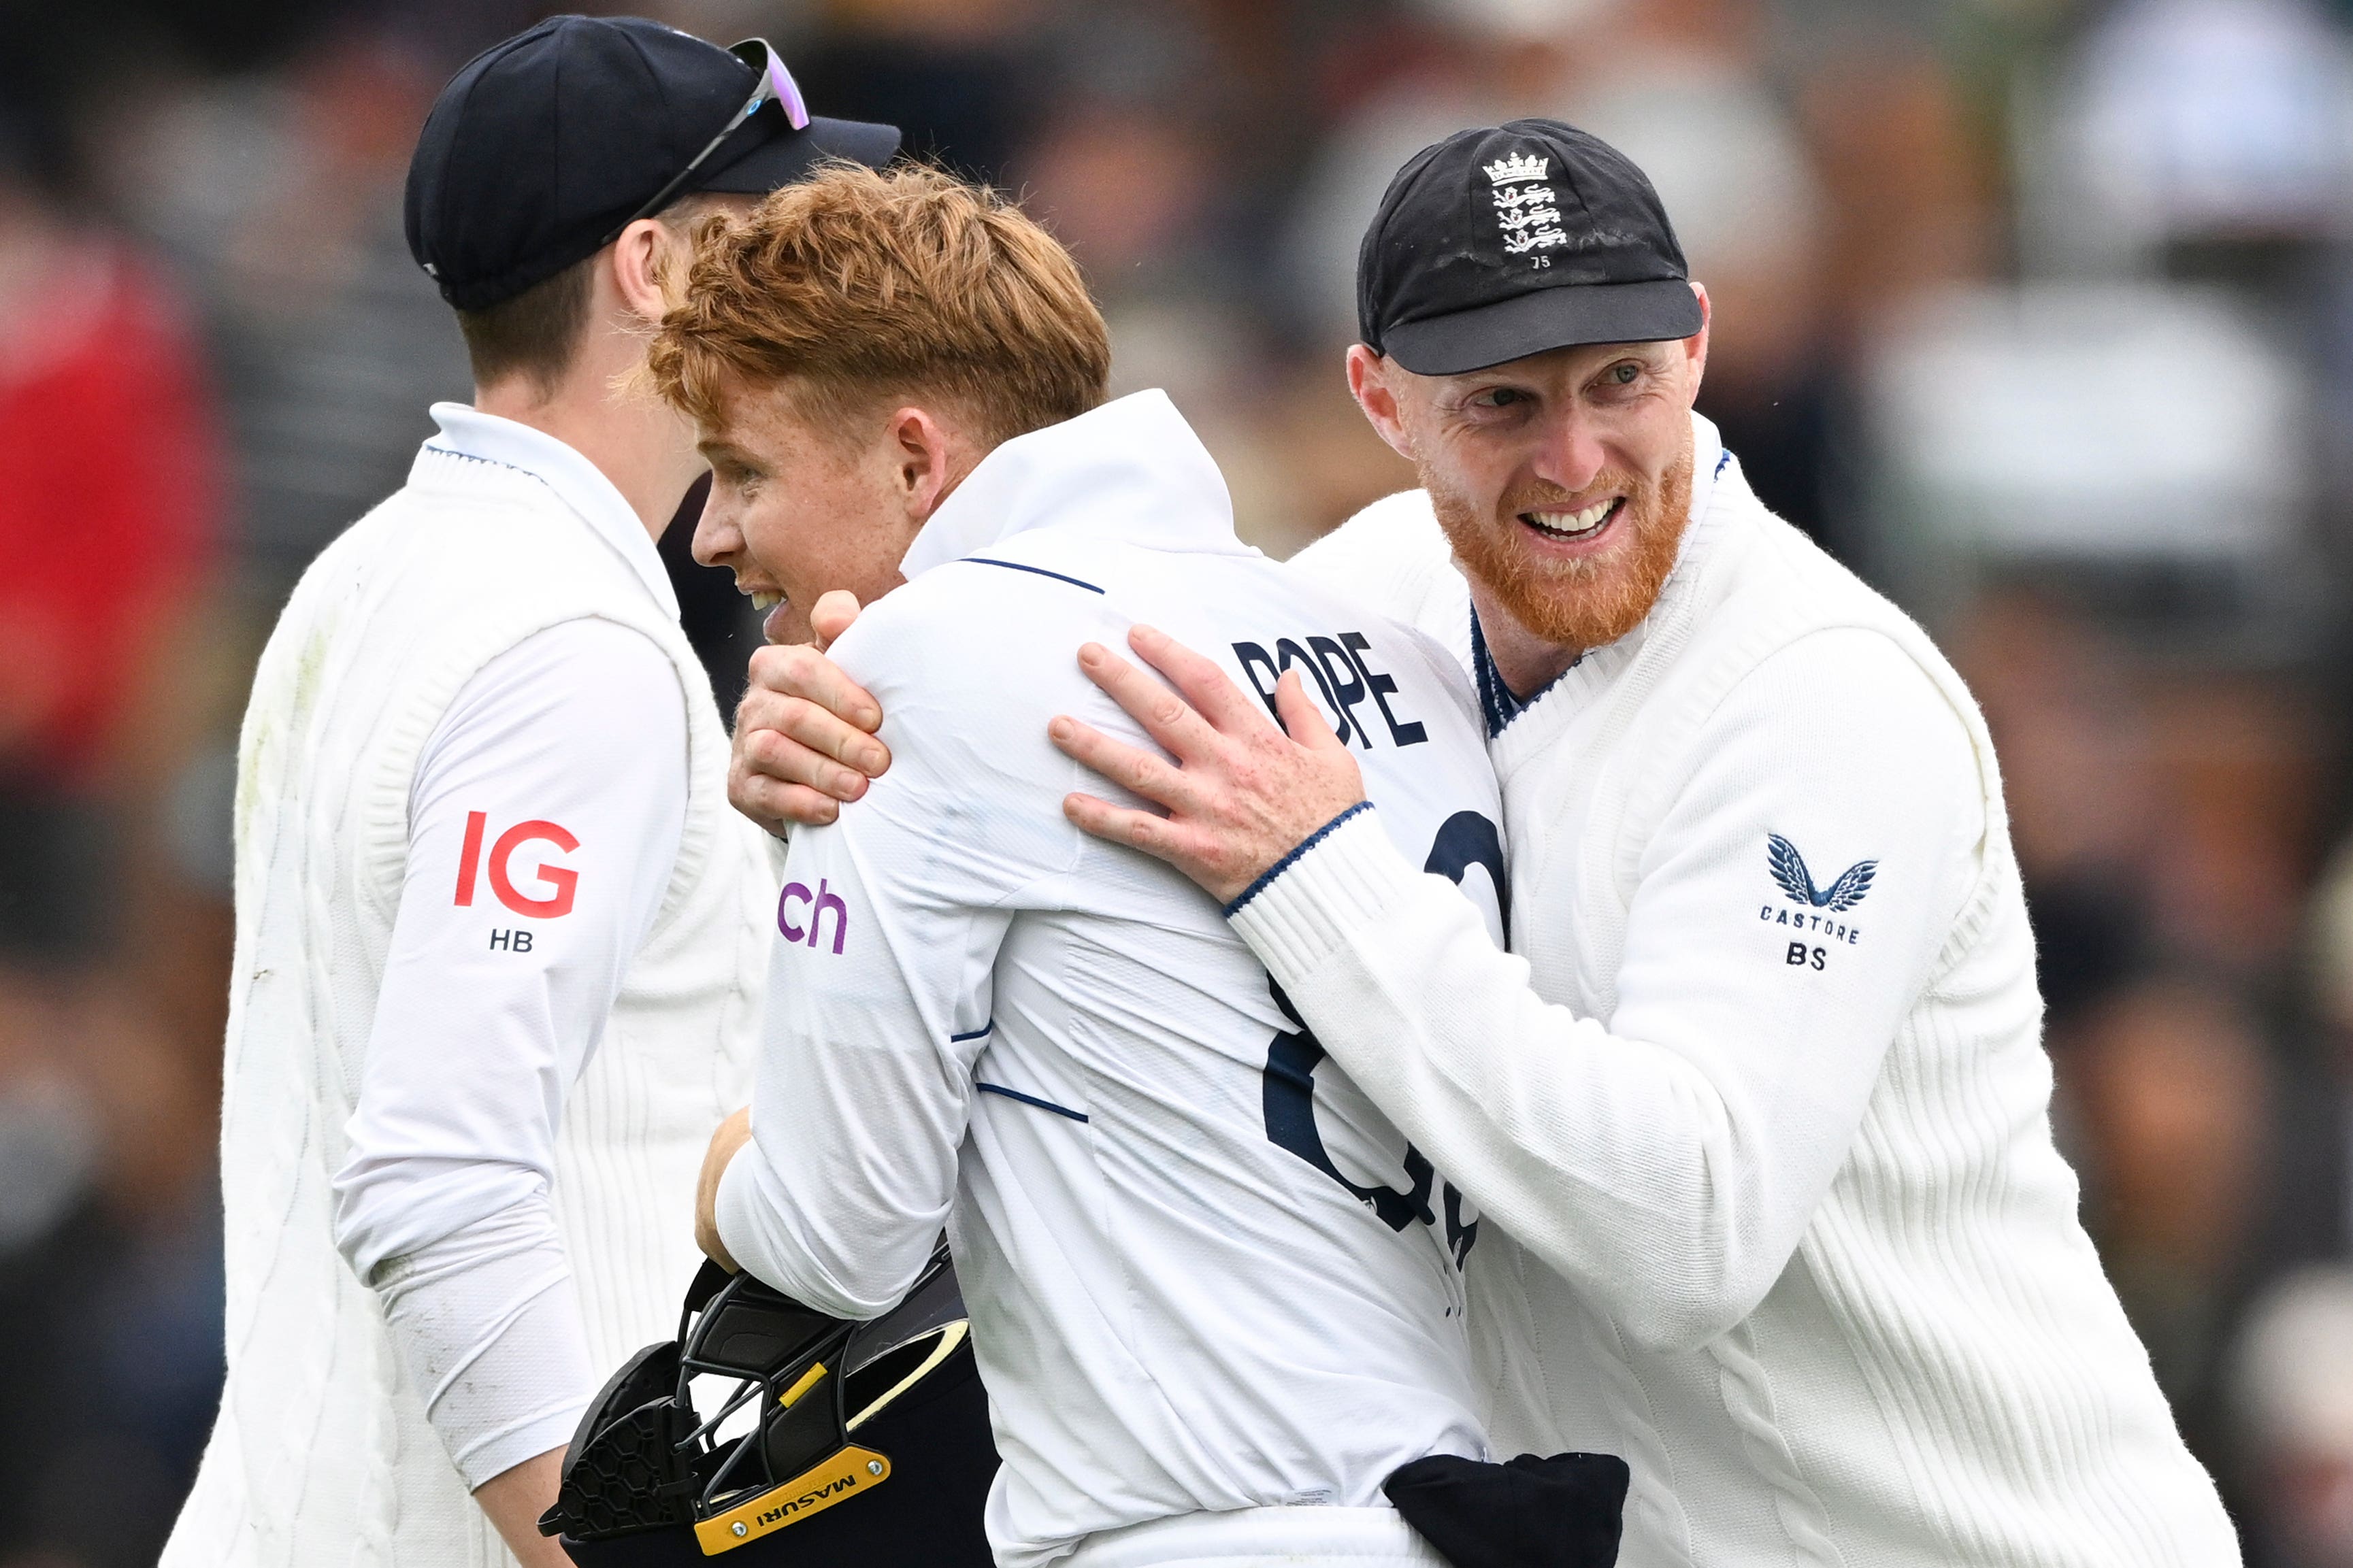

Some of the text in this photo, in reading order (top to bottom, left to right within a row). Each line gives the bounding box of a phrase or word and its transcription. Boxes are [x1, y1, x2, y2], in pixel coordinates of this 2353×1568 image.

[1530, 255, 1551, 269] 75
[1231, 631, 1429, 750] POPE
[454, 810, 581, 919] IG
[489, 928, 533, 953] HB
[1760, 905, 1860, 945] CASTORE
[1786, 941, 1826, 971] BS
[756, 1474, 857, 1527] MASURI
